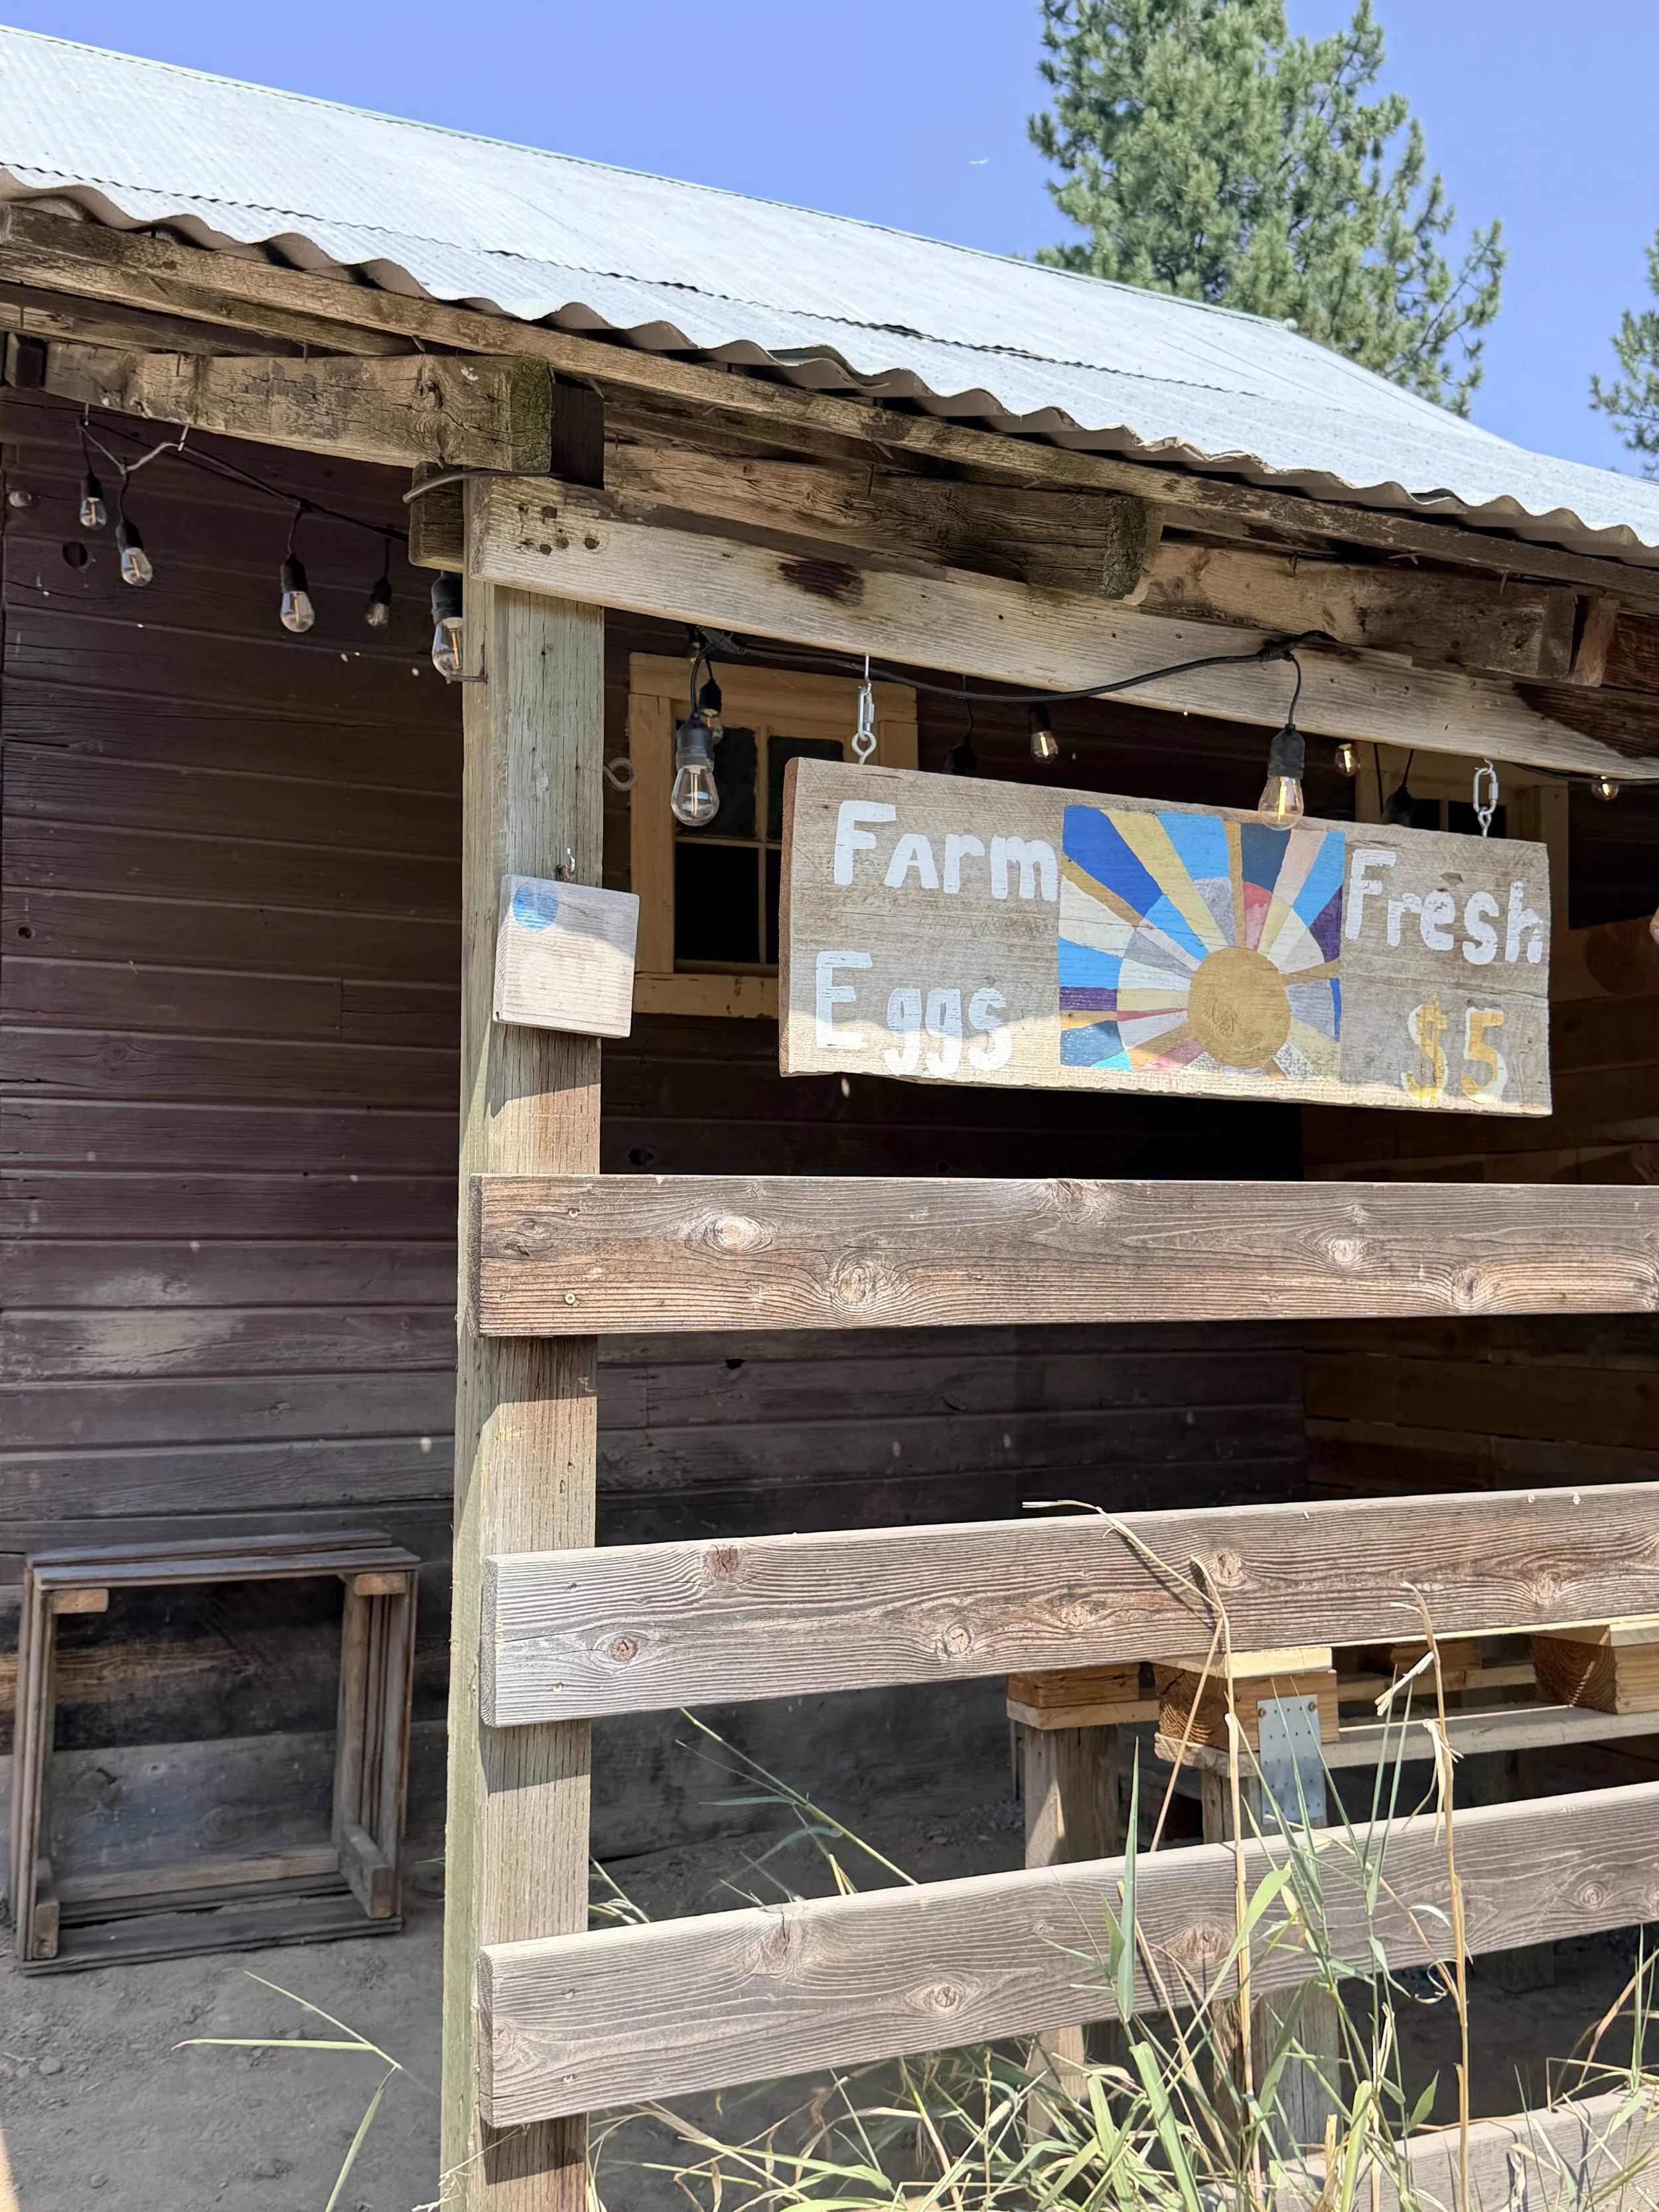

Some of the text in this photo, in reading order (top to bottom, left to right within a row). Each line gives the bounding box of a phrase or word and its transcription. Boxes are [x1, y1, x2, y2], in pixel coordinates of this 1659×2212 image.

[1344, 848, 1544, 965] Fresh
[816, 950, 1013, 1076] Eggs
[1400, 994, 1508, 1106] $5
